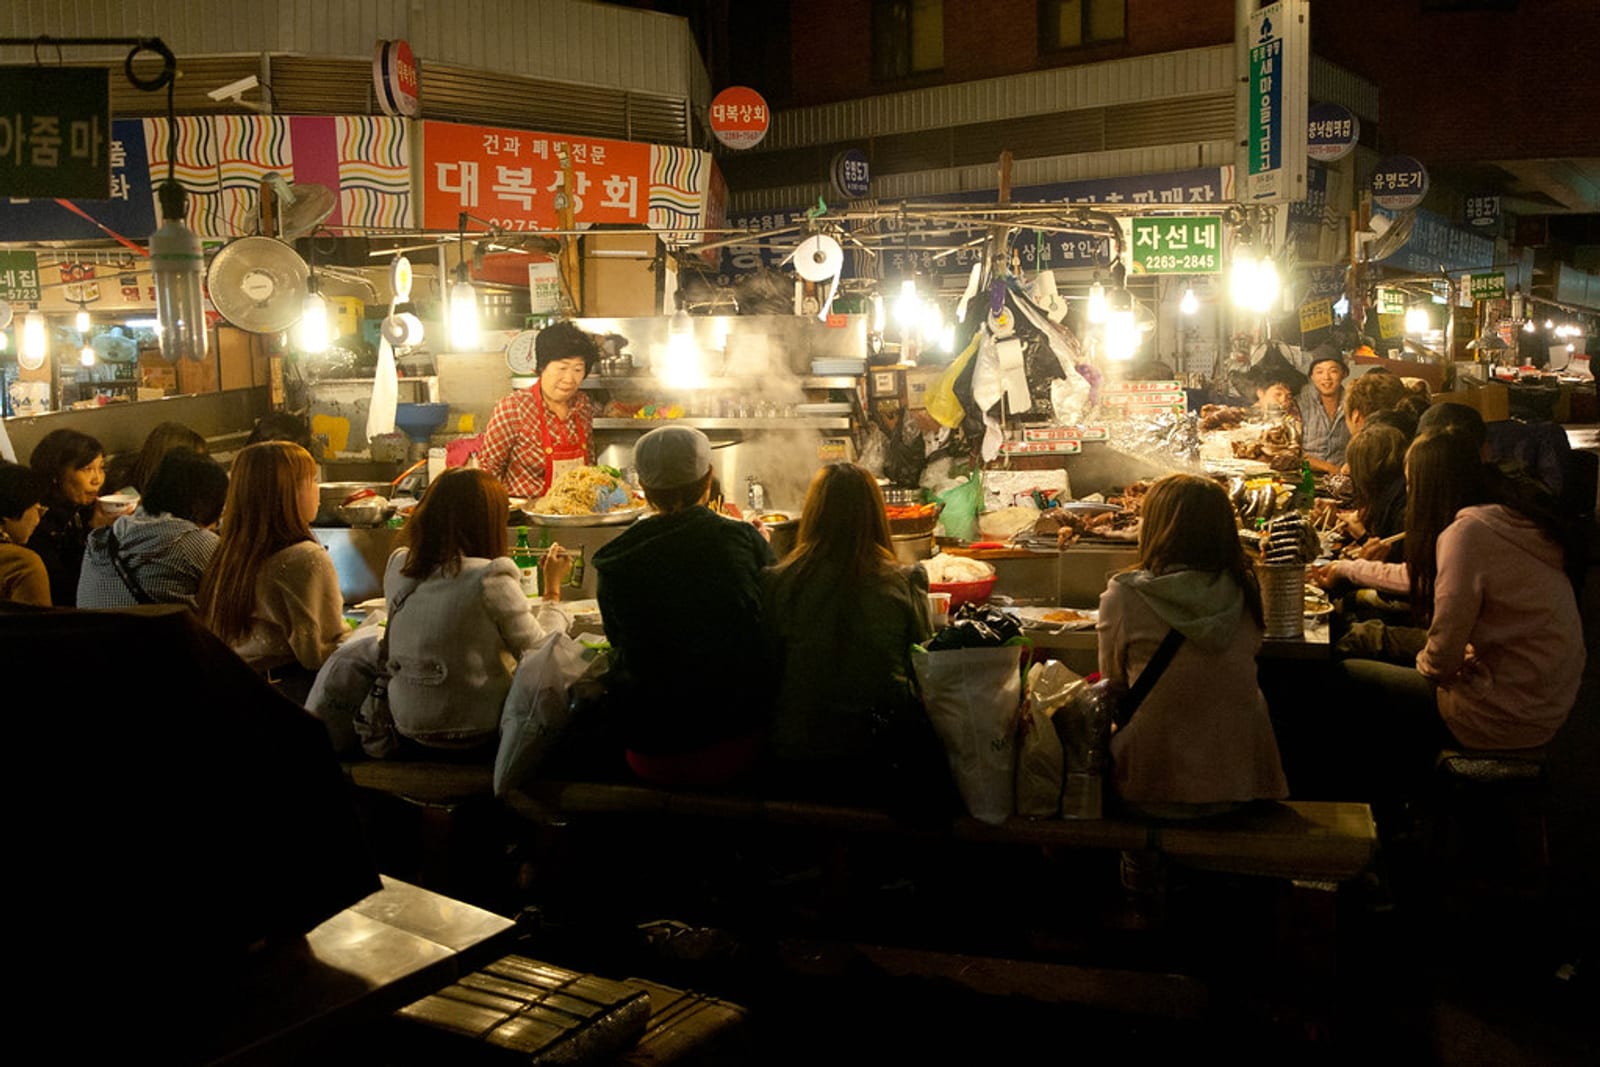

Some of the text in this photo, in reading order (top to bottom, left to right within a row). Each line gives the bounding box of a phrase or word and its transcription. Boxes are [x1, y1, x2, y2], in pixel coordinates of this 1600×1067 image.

[712, 104, 766, 123] 대복상회
[1260, 58, 1273, 172] 새마을금고
[0, 112, 104, 167] 아줌마
[482, 134, 522, 157] 건과
[434, 160, 639, 219] 대복상회
[1372, 171, 1422, 190] 유명도기
[1136, 224, 1216, 250] 자선네
[1146, 254, 1215, 269] 2263-2845
